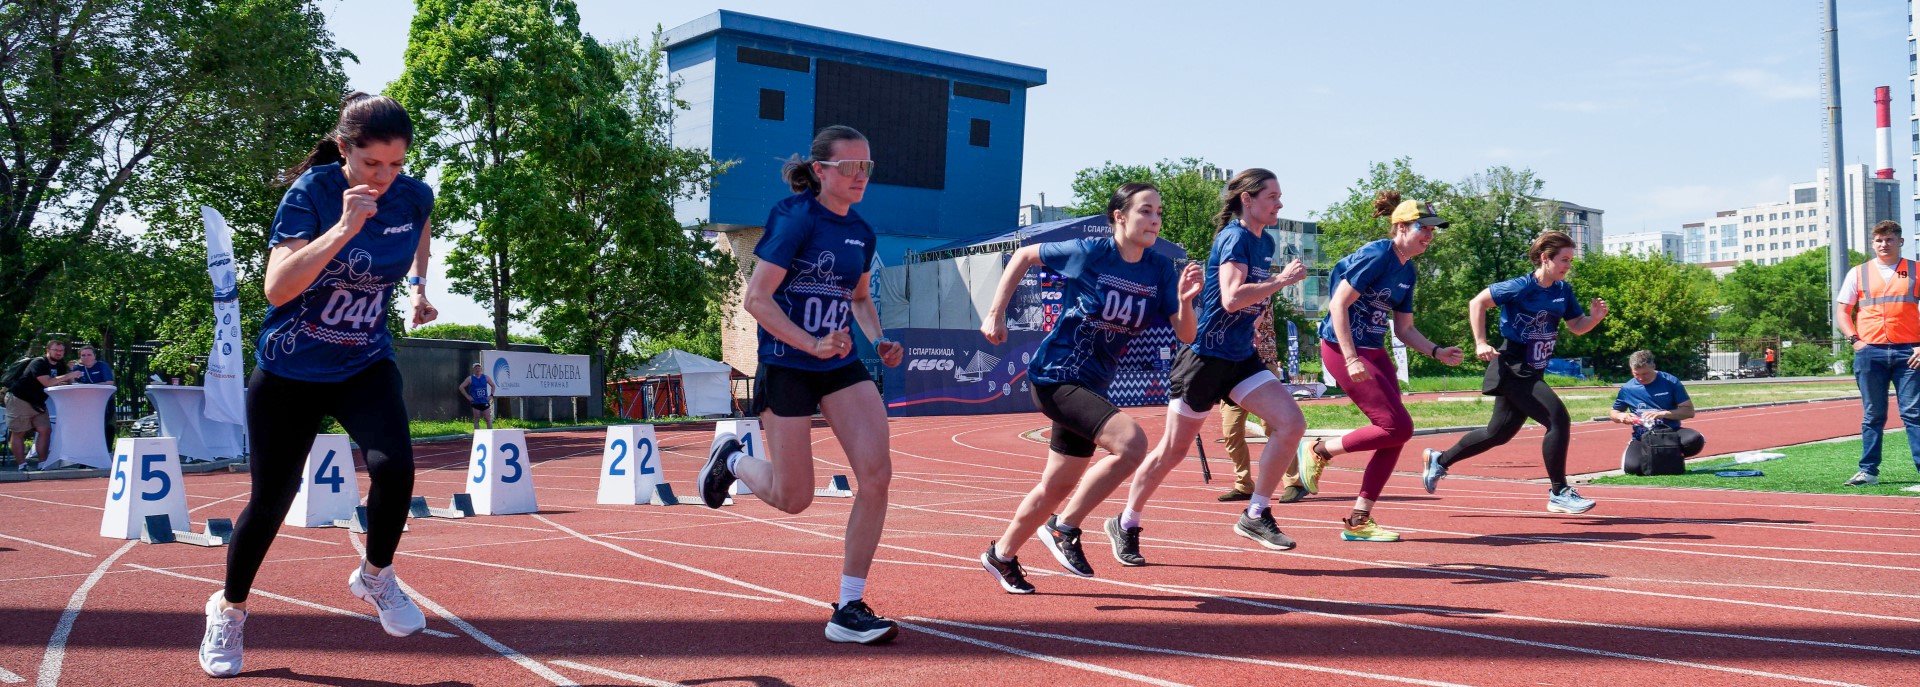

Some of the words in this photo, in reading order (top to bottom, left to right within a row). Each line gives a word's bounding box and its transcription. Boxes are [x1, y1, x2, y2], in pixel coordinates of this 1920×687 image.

[1087, 225, 1114, 234] СПАРТА
[1896, 270, 1908, 279] 19
[321, 289, 383, 329] 044
[803, 296, 850, 335] 042
[1102, 290, 1147, 328] 041
[907, 359, 955, 371] FESCO
[912, 348, 955, 356] СПАРТАКИАДА
[525, 363, 581, 380] АСТАФЬЕВА
[540, 380, 569, 389] ТЕРМИНАЛ
[472, 443, 487, 484] 3
[499, 443, 523, 484] 3
[609, 439, 628, 476] 2
[637, 437, 655, 475] 2
[740, 432, 754, 457] 1
[112, 454, 128, 501] 5
[141, 454, 172, 501] 5
[314, 449, 345, 493] 4
